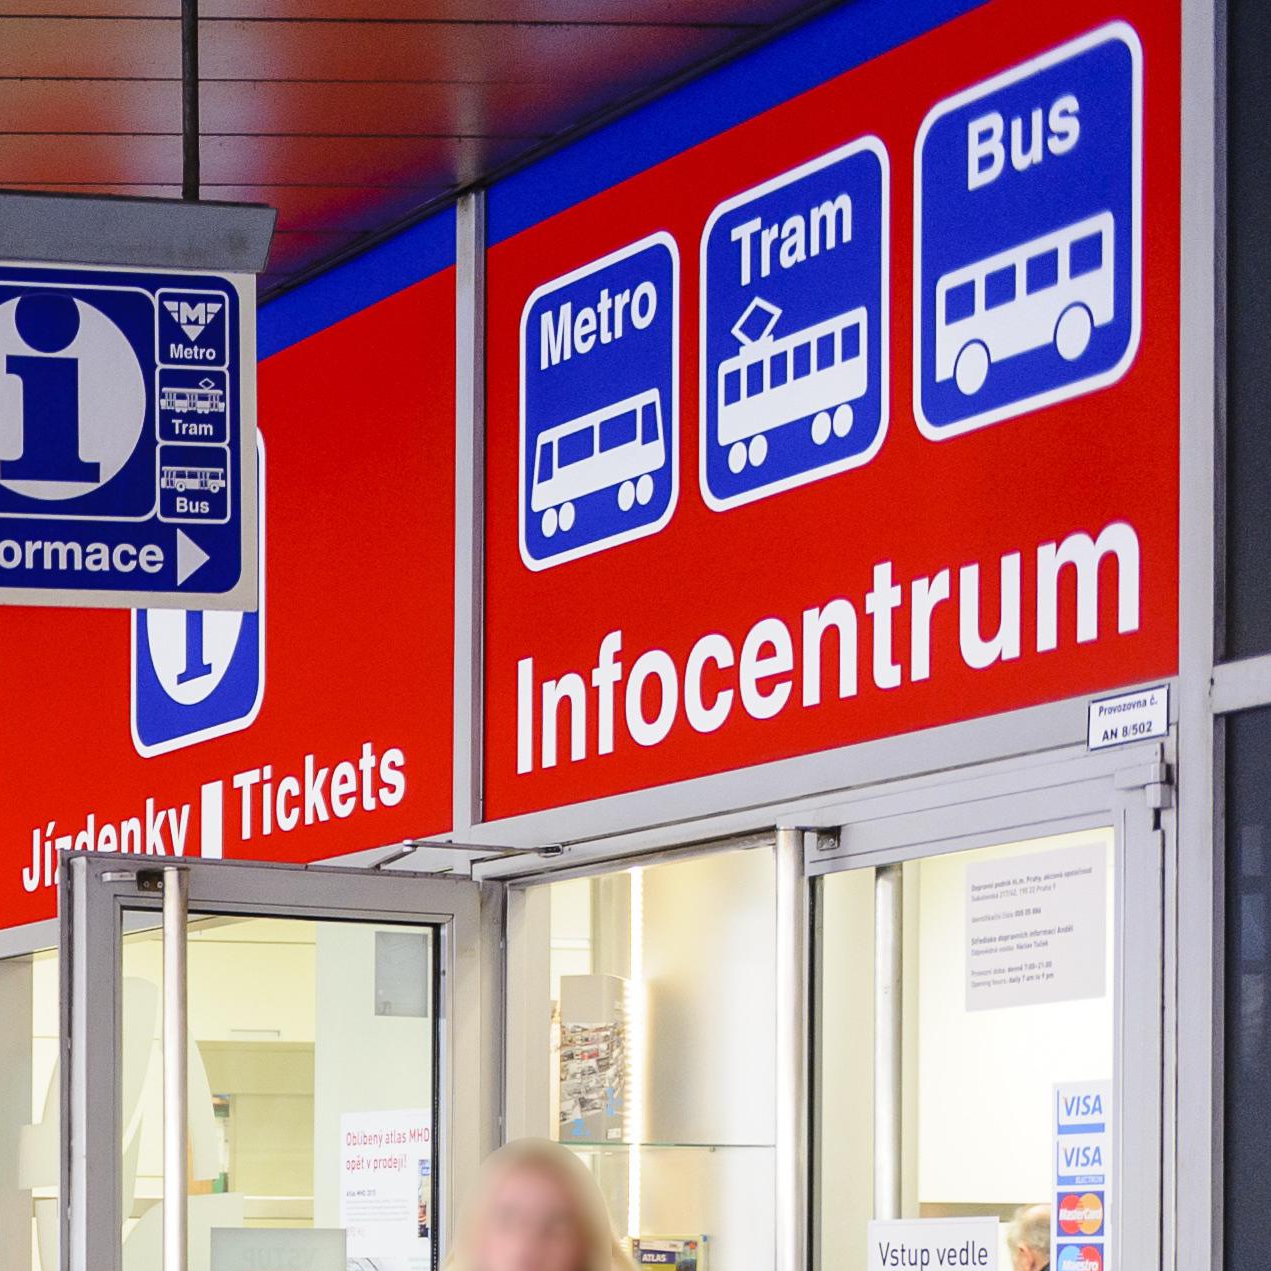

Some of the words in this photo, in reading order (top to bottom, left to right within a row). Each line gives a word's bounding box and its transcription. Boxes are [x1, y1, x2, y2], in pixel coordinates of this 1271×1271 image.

[966, 93, 1082, 191] Bus
[730, 192, 854, 287] Tram
[539, 280, 658, 371] Metro
[169, 343, 217, 361] Metro
[171, 419, 214, 436] Tram
[175, 497, 210, 514] Bus
[516, 520, 1141, 776] Infocentrum
[1098, 698, 1147, 717] Provozovna
[1101, 728, 1119, 742] AN
[1121, 720, 1153, 738] 8/502
[232, 742, 407, 842] Tickets
[1063, 1094, 1103, 1117] VISA
[385, 1130, 407, 1145] atlas
[409, 1127, 430, 1143] MHD
[1063, 1145, 1103, 1168] VISA
[642, 1253, 667, 1262] ATLAS
[936, 1240, 989, 1267] vedle
